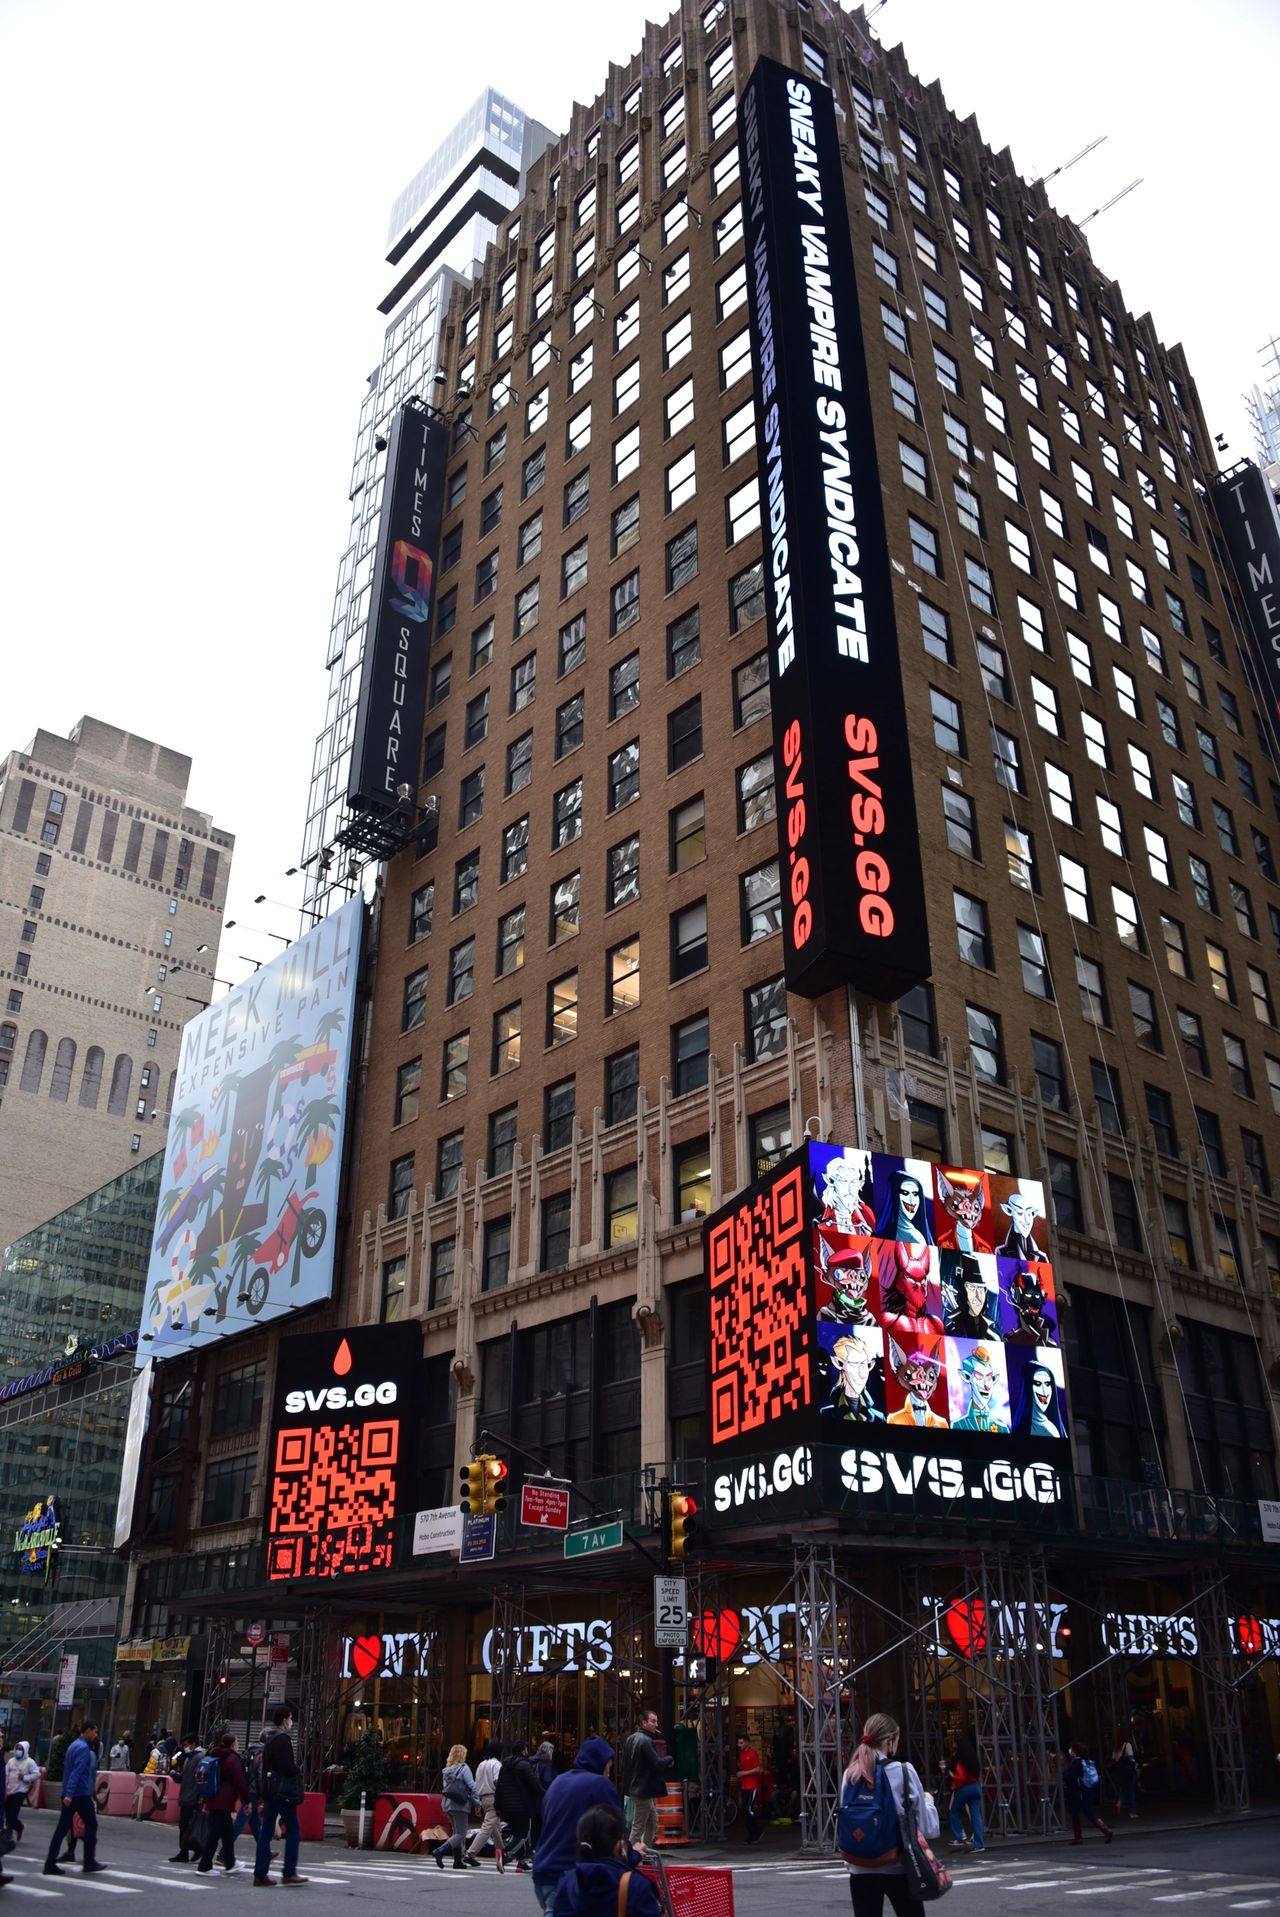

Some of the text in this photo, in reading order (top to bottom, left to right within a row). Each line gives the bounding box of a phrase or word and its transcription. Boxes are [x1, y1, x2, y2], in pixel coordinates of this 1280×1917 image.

[744, 84, 796, 677] SNEAKY VAMPIRE SYNDICATE
[786, 78, 869, 663] SNEAKY VAMPIRE SYNDICATE
[411, 424, 431, 538] TIMES
[384, 626, 410, 793] SQUARE
[783, 719, 813, 950] SVS.GG
[844, 713, 895, 938] SVS.GG
[183, 915, 351, 1075] MEEK MILL
[178, 965, 349, 1101] EXPENSIVE PAIN
[284, 1381, 398, 1414] SVS.GG
[539, 1489, 560, 1499] Standing
[714, 1446, 813, 1512] SVS.GG
[840, 1449, 1062, 1504] SVS.GG
[420, 1513, 429, 1524] 570
[438, 1510, 457, 1520] Avenue
[430, 1528, 456, 1539] Construction
[467, 1517, 490, 1526] PLATINUM
[528, 1503, 561, 1514] Except Sunday
[582, 1536, 589, 1549] 7
[659, 1605, 684, 1624] 25
[991, 1600, 1069, 1658] NY
[1101, 1612, 1199, 1656] GIFTS
[339, 1632, 437, 1678] I NY
[482, 1620, 613, 1675] GIFTS
